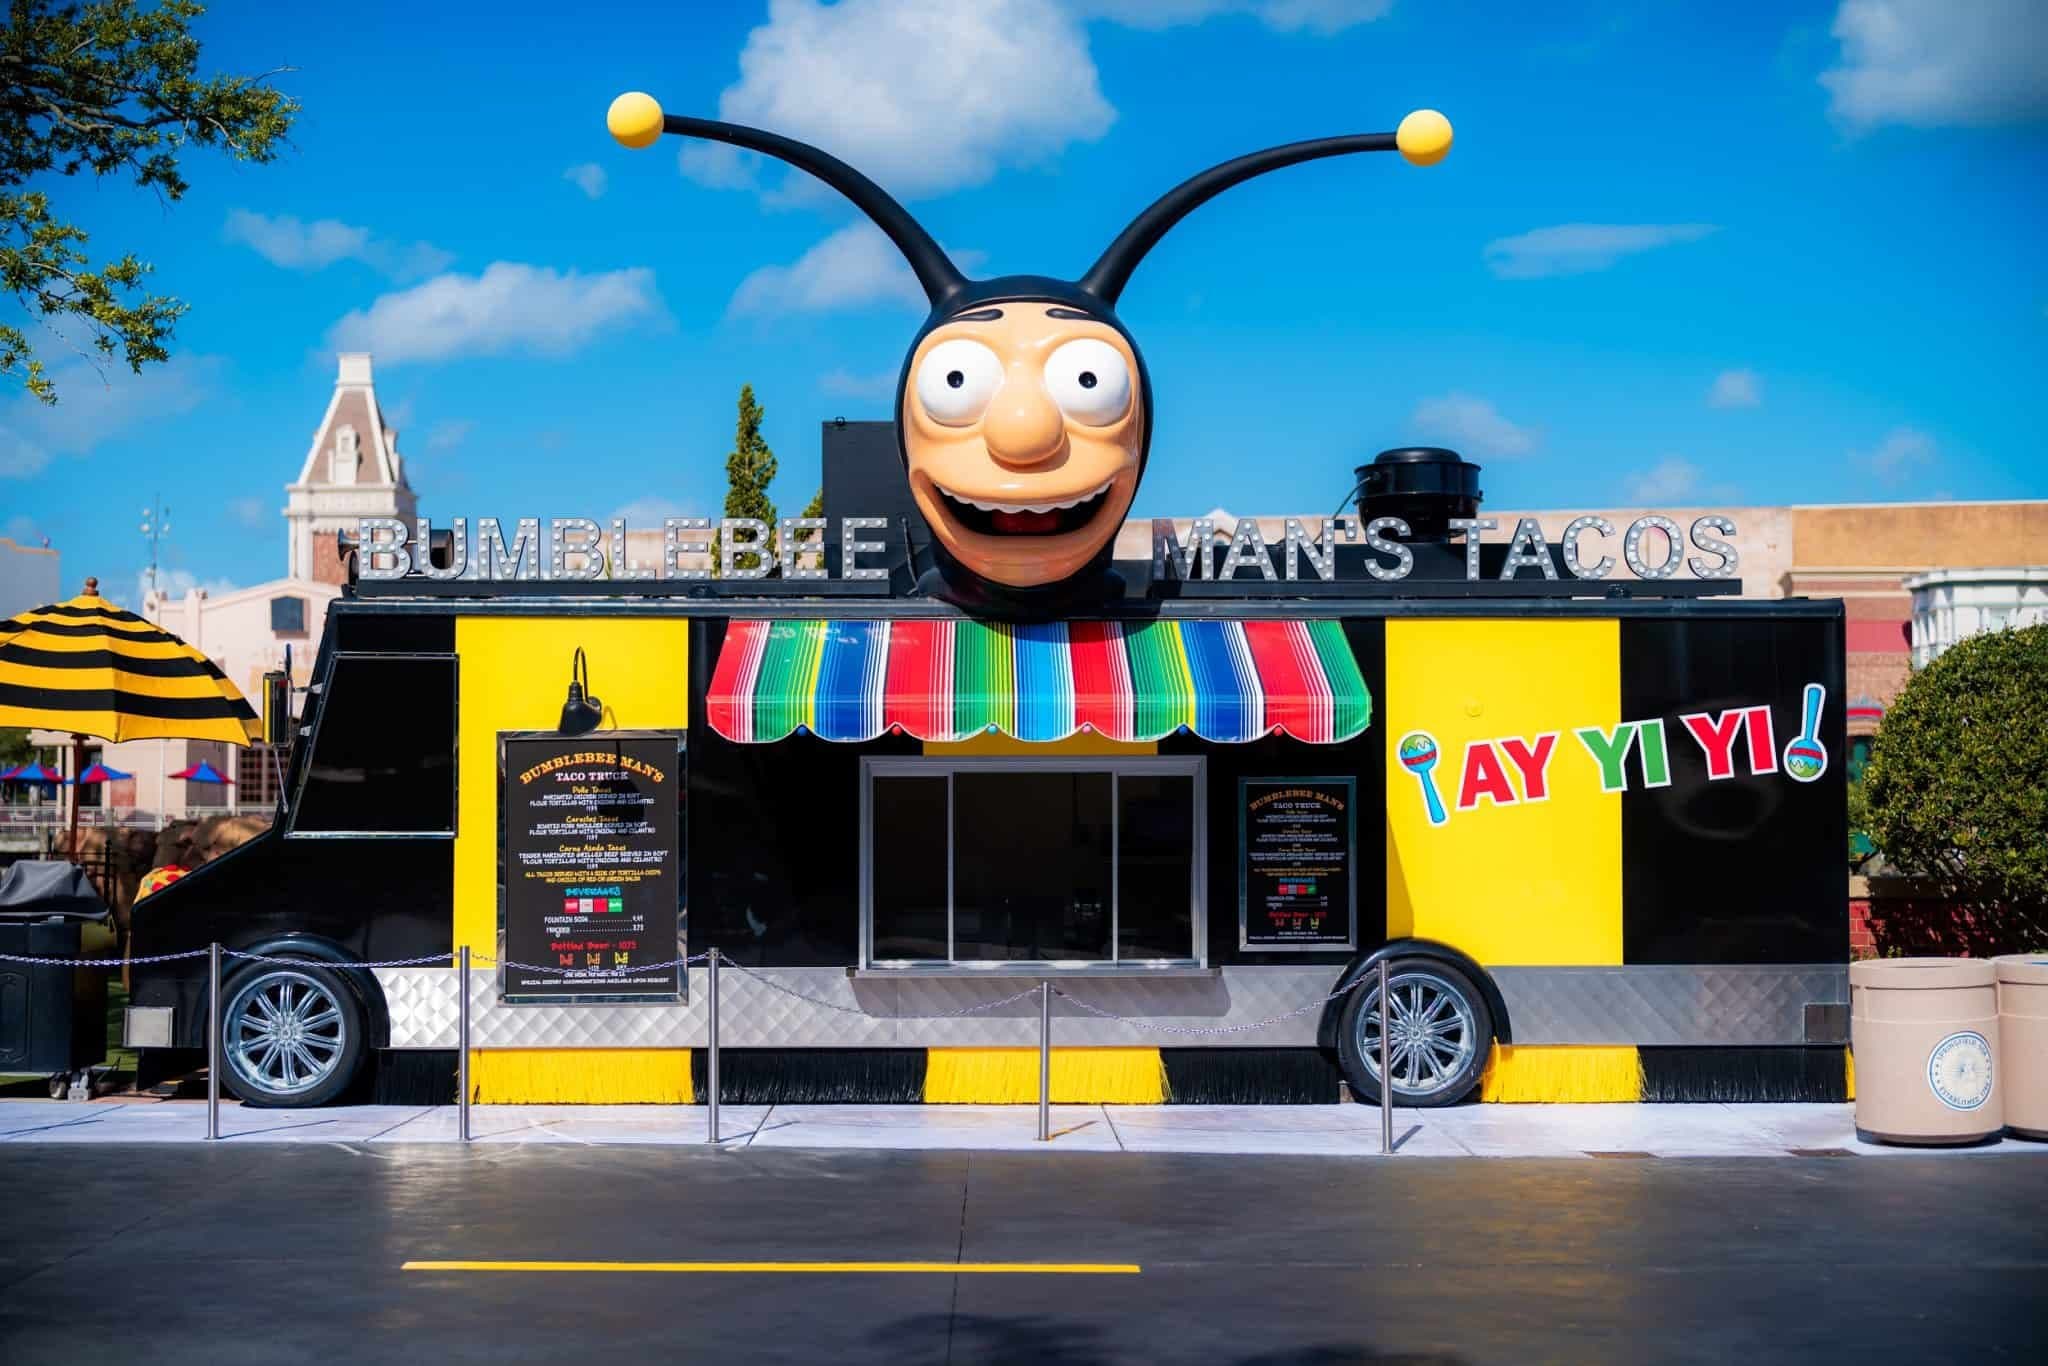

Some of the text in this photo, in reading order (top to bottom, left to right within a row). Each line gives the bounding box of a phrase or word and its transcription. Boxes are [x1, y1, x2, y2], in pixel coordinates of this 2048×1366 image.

[358, 516, 1739, 581] BUMBLEBEE MAN'S TACOS
[519, 752, 665, 785] BUMBLEBEE MAN'S
[555, 771, 629, 782] TACO TRUCK
[1456, 731, 1560, 811] AY
[1575, 717, 1672, 793] YI
